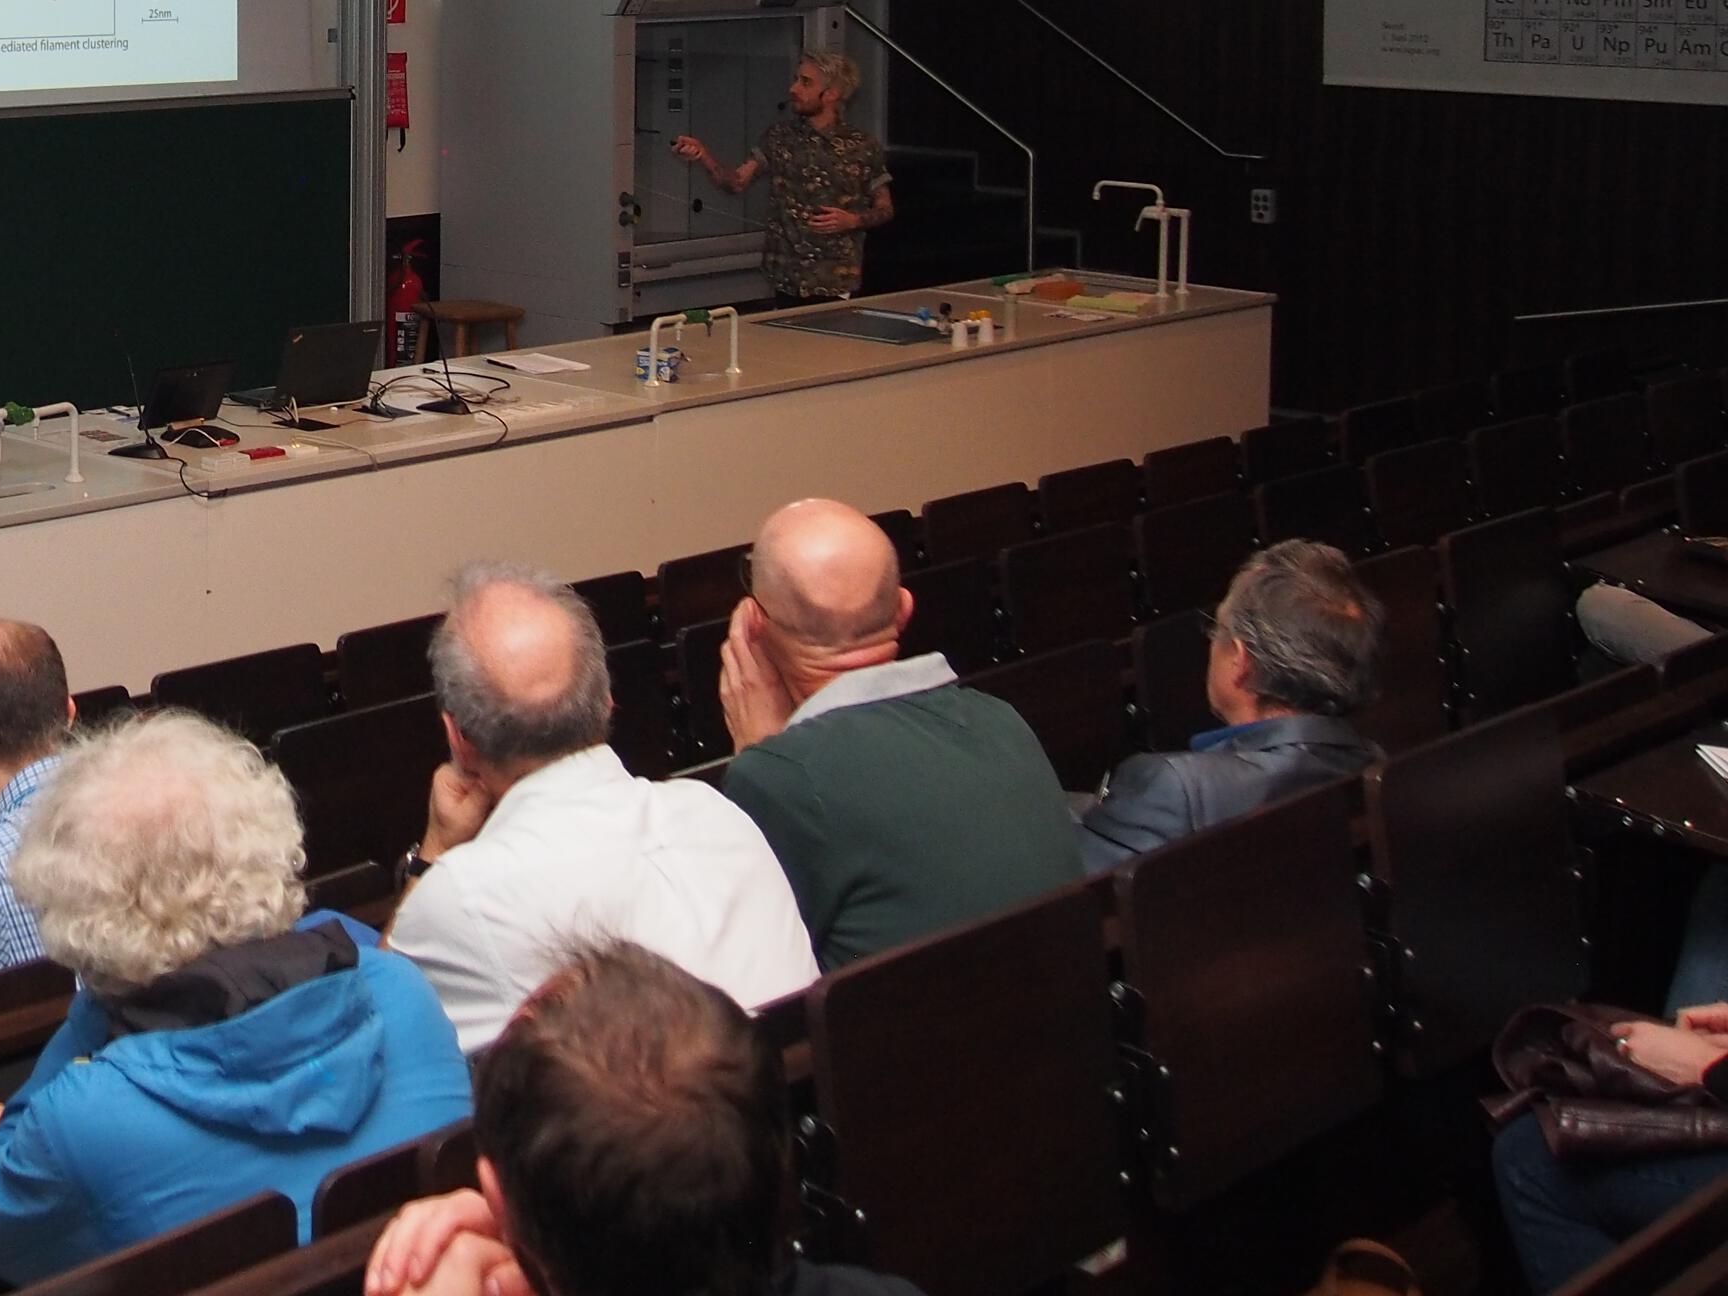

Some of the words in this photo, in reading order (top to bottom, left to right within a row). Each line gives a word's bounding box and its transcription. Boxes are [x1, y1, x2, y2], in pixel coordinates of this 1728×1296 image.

[148, 8, 172, 19] 25nm
[40, 38, 80, 51] filament
[82, 37, 128, 51] clustering
